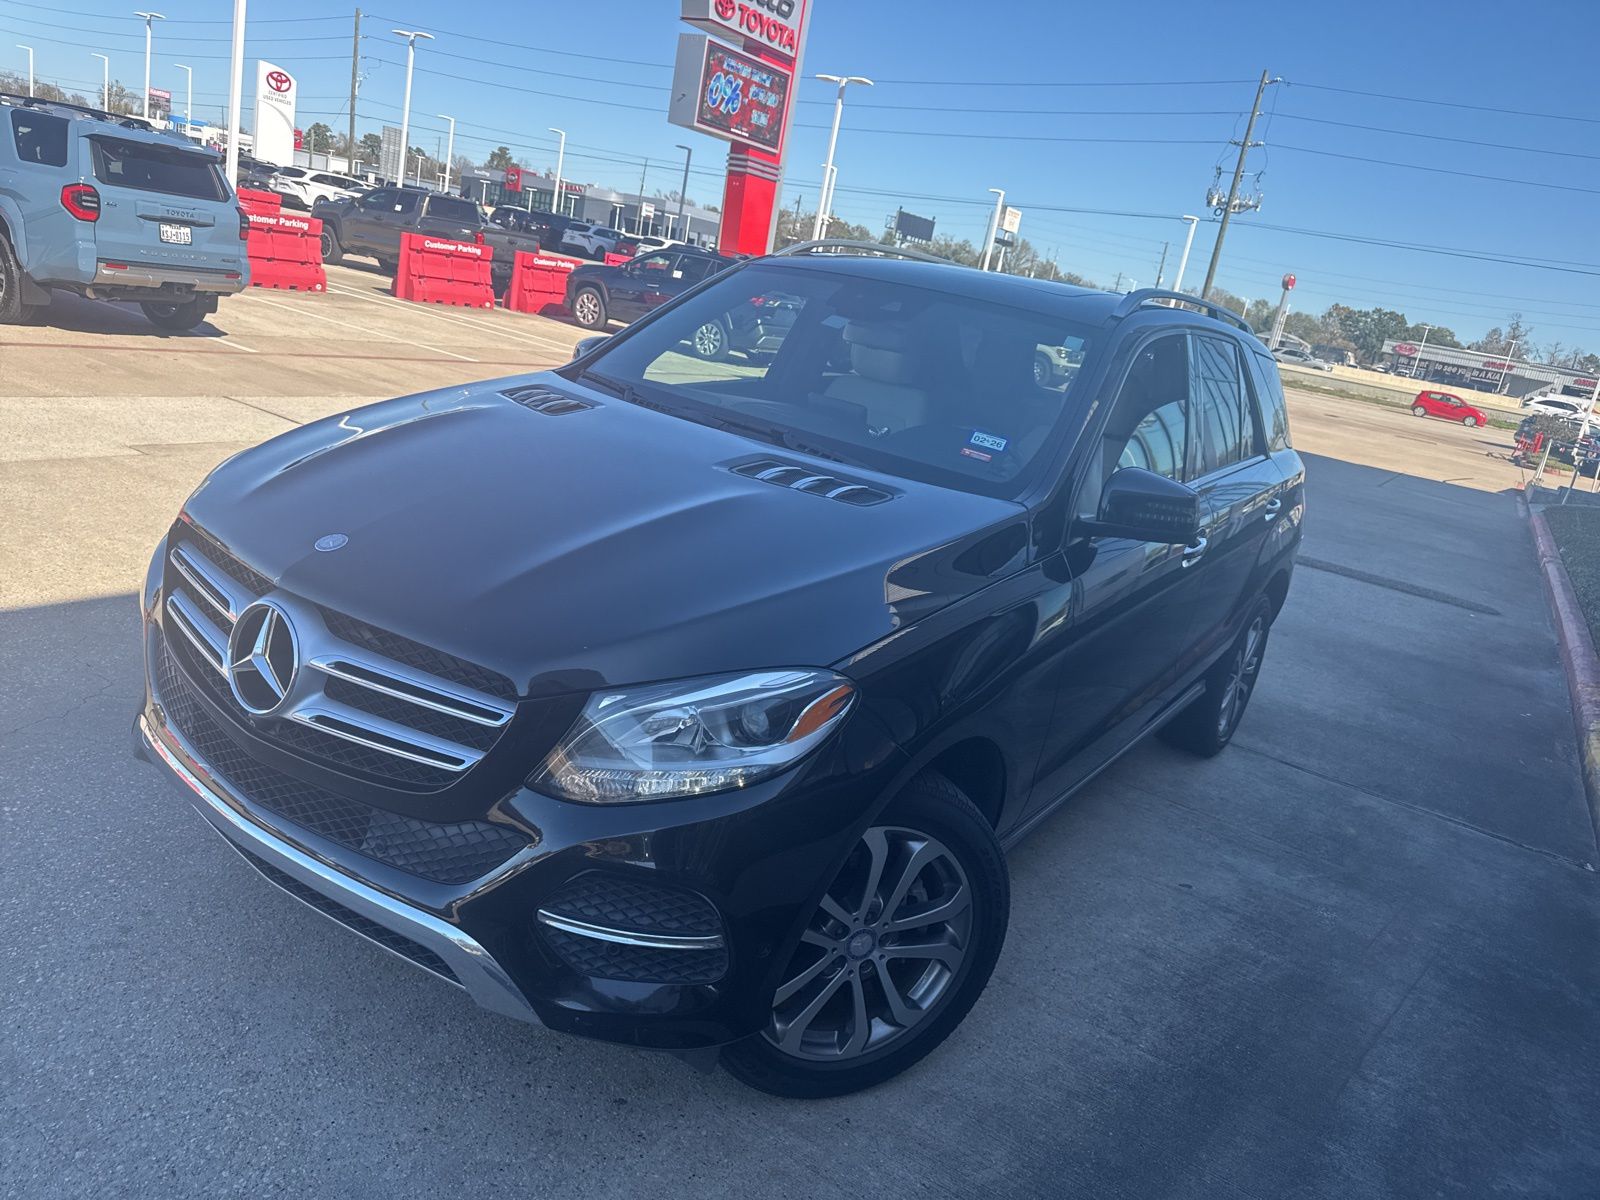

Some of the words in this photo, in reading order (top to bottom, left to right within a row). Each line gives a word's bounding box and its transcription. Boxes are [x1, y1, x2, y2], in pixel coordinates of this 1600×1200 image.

[738, 3, 795, 51] TOYOTA
[708, 71, 743, 114] 0%
[166, 208, 195, 218] TOYOTA
[279, 217, 309, 231] Parking
[424, 240, 457, 251] Customer
[457, 244, 482, 256] Parking
[533, 257, 557, 267] Customer
[1443, 365, 1457, 373] see
[1486, 371, 1501, 380] KIA
